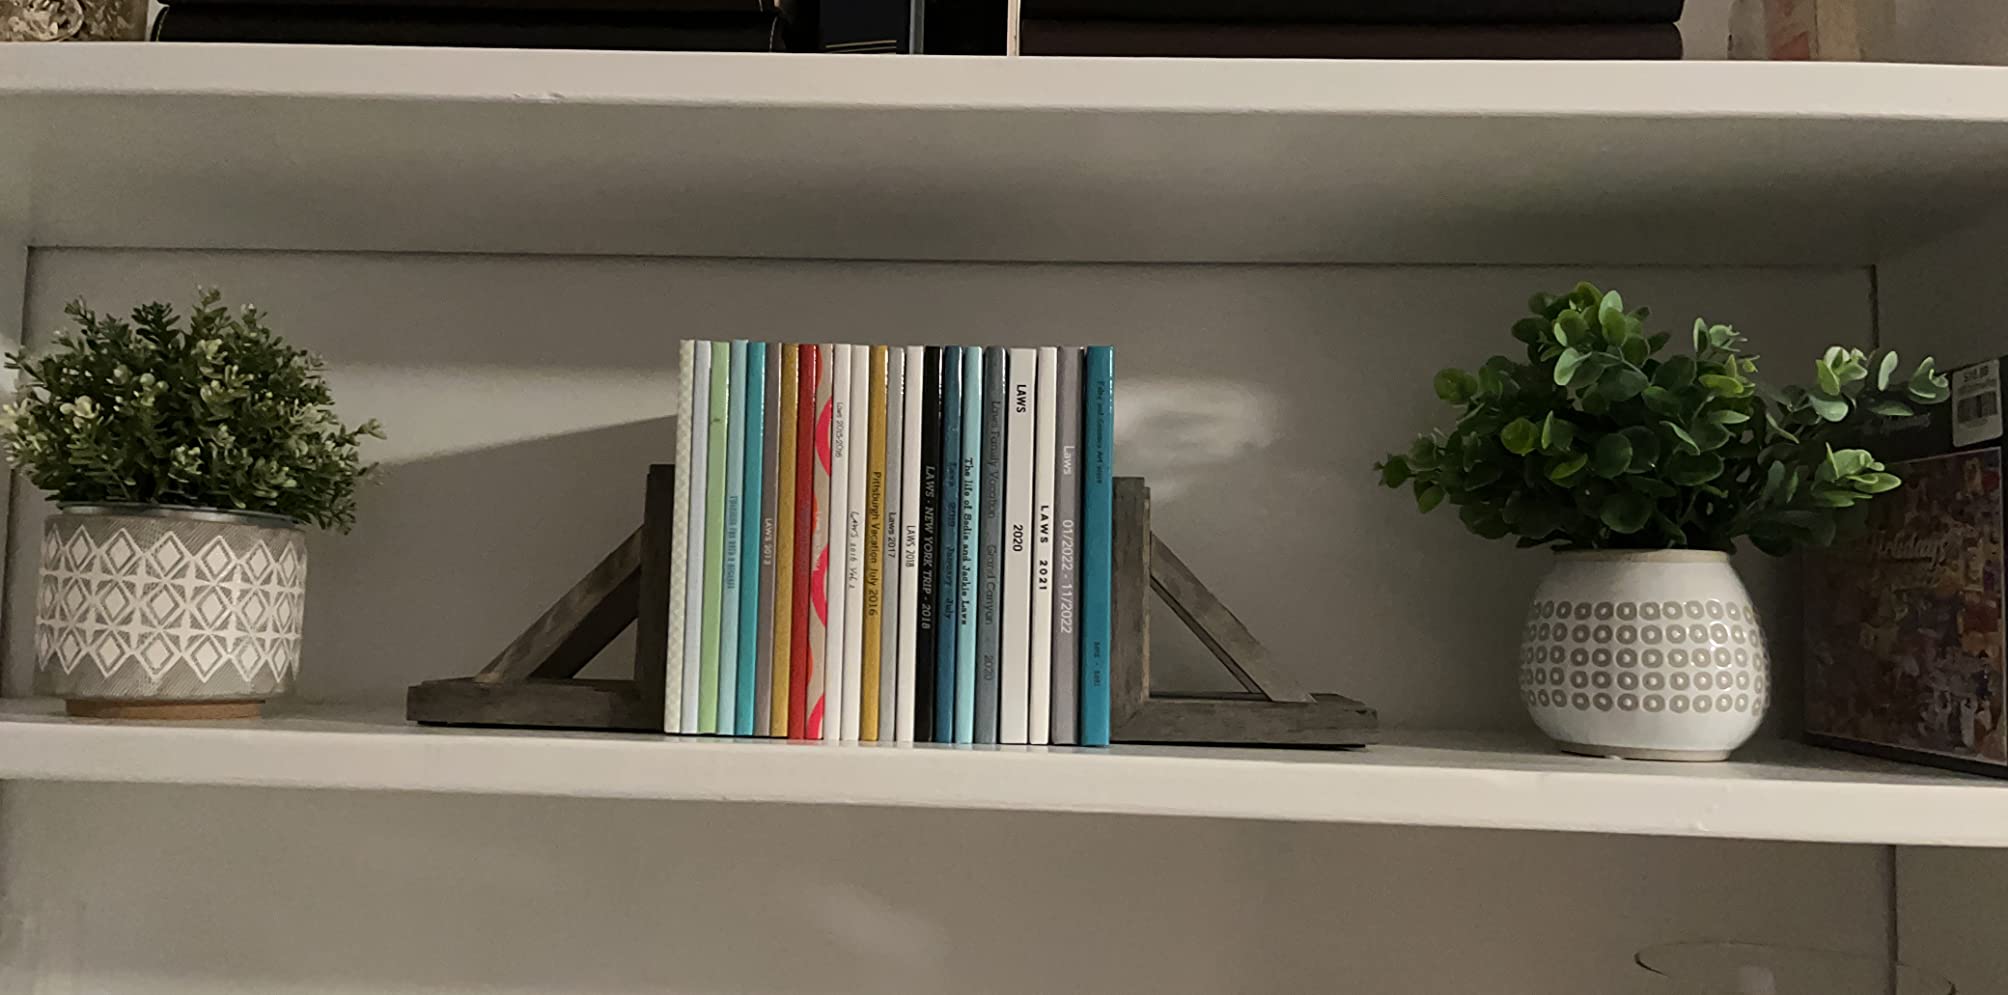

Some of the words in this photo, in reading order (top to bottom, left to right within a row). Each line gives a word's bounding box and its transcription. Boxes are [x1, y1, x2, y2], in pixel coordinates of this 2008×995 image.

[836, 401, 845, 418] Laws
[1015, 384, 1027, 413] LAWS
[986, 431, 1000, 467] Family
[1062, 445, 1075, 475] Laws
[964, 458, 974, 477] The
[924, 465, 936, 498] LAWS
[963, 480, 973, 496] life
[987, 470, 999, 519] Vacation
[870, 471, 882, 520] Pittsburgh
[963, 499, 973, 510] of
[764, 517, 773, 542] LAWS
[887, 511, 897, 535] Laws
[923, 506, 935, 533] NEW
[1039, 505, 1049, 544] LAWS
[870, 523, 881, 564] Vacation
[887, 536, 896, 558] 2017
[905, 525, 916, 548] LAWS
[1012, 524, 1024, 552] 2020
[1060, 519, 1074, 571] 01/2022
[904, 549, 915, 568] 2018
[922, 536, 934, 567] YORK
[962, 544, 971, 562] and
[986, 544, 998, 579] Grand
[867, 567, 879, 586] July
[921, 570, 933, 595] TRIP
[961, 565, 971, 597] Jackie
[1038, 560, 1048, 591] 2021
[868, 589, 878, 617] 2016
[921, 603, 932, 630] 2018
[943, 597, 955, 619] July
[961, 600, 970, 625] Laws
[984, 581, 996, 625] Canyon
[1059, 583, 1073, 634] 11/2022
[983, 654, 994, 681] 2020
